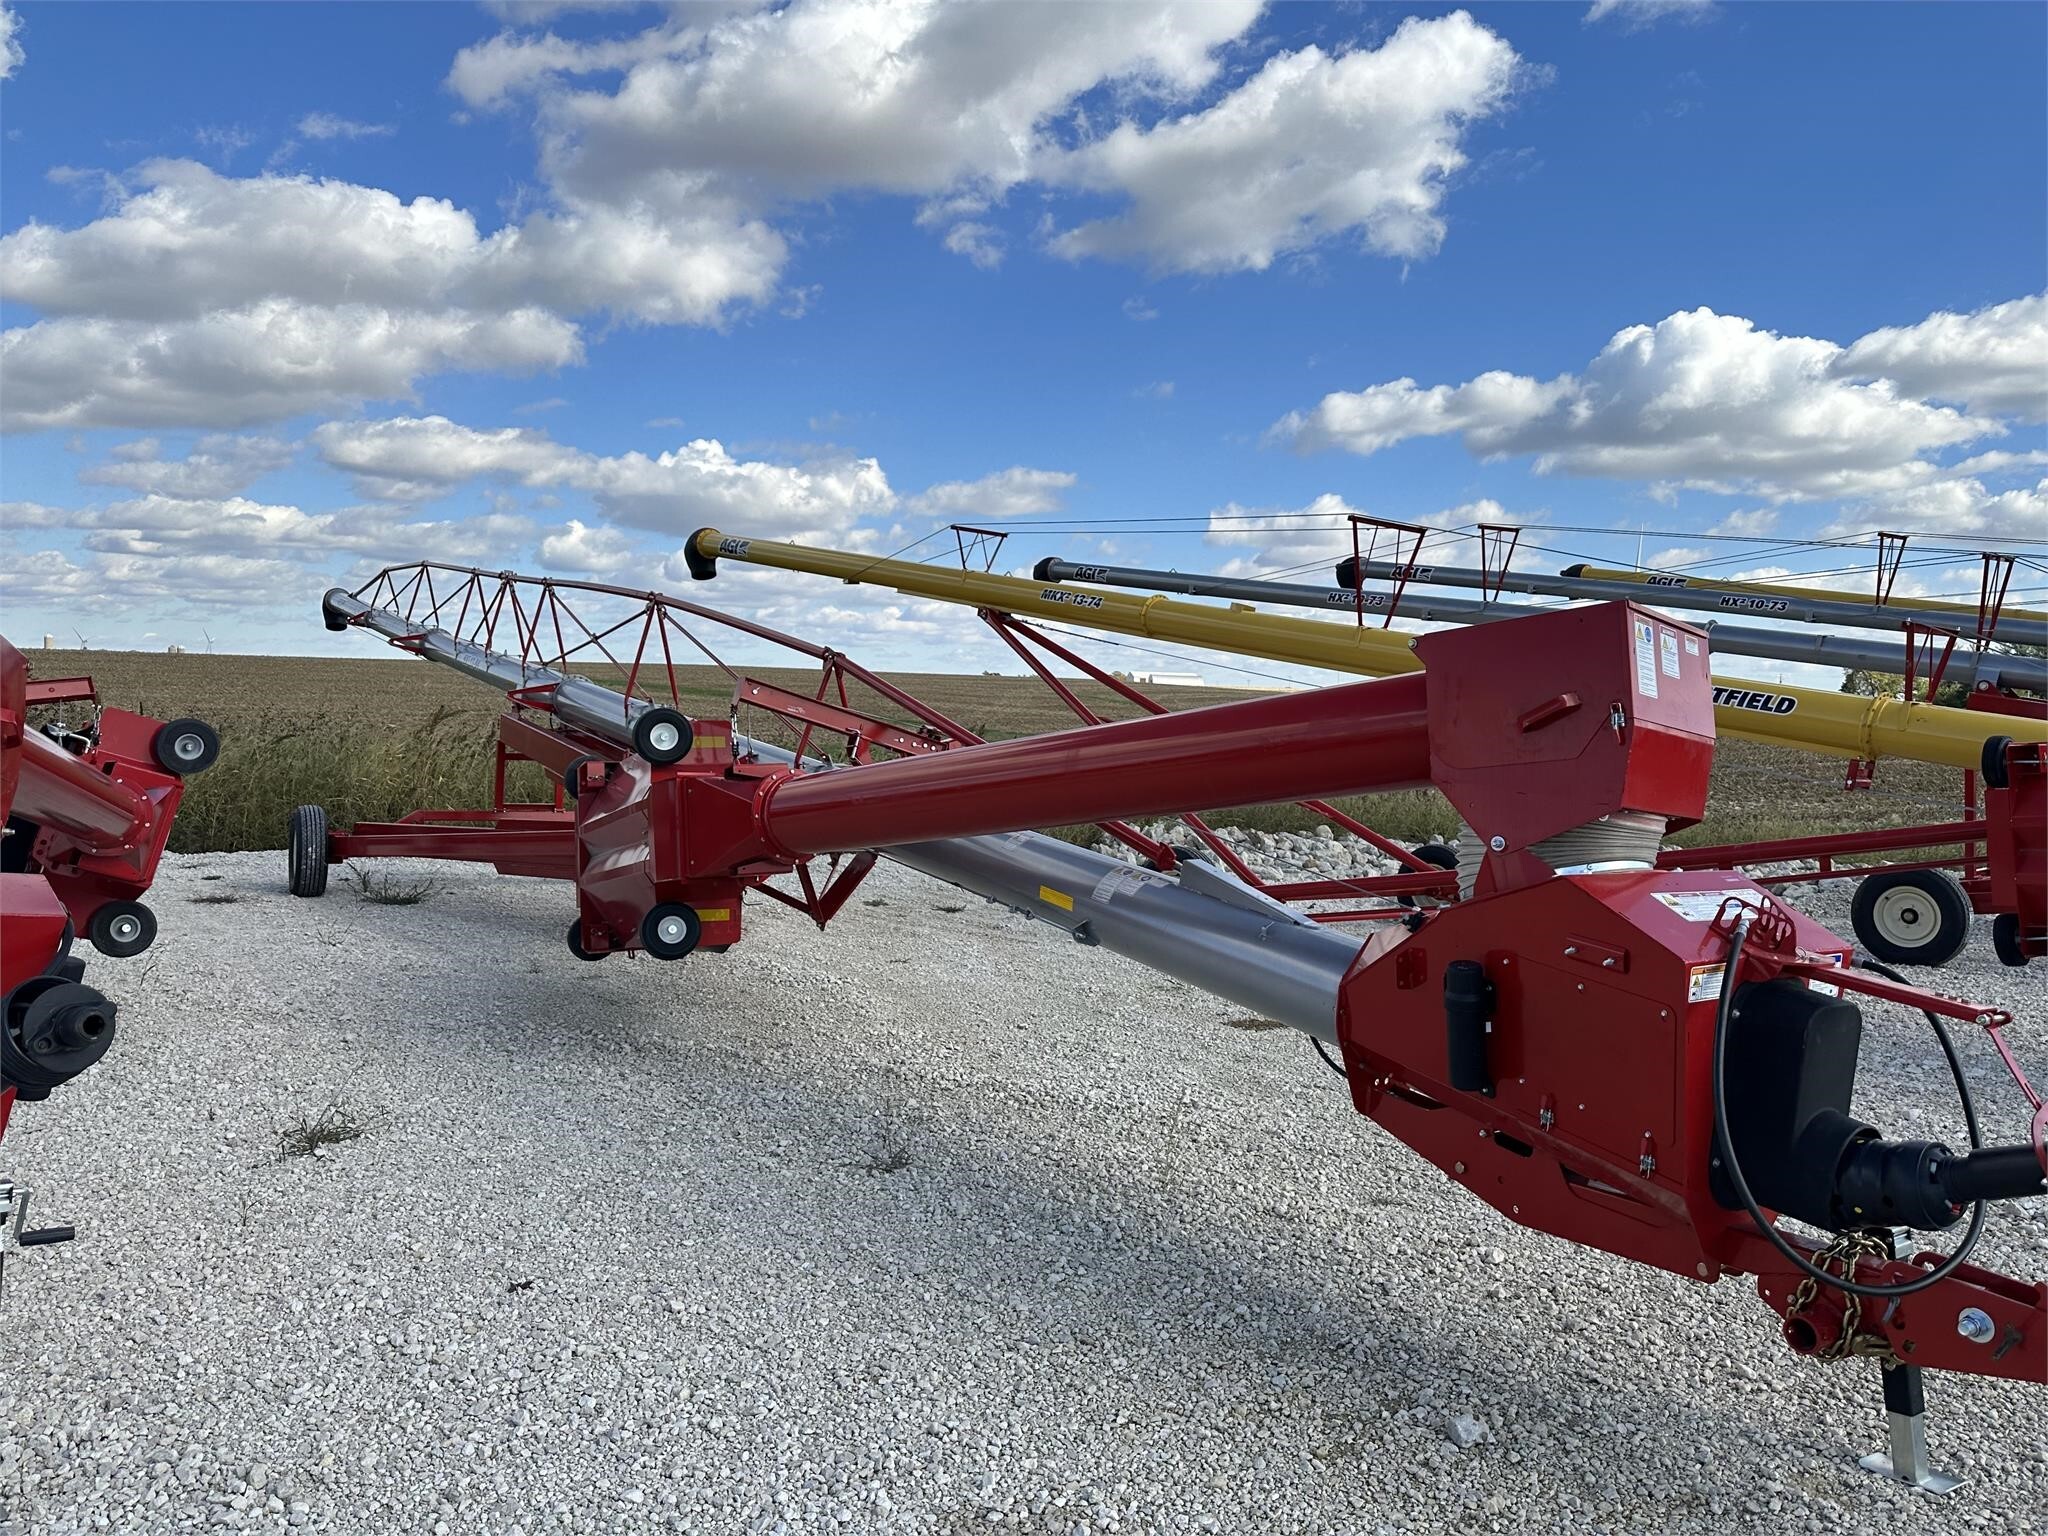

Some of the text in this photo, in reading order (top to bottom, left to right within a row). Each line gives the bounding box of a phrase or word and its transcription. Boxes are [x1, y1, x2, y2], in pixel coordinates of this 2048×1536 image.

[719, 538, 742, 555] AGI
[1073, 566, 1098, 581] AGI
[1646, 575, 1676, 587] AGI
[1072, 593, 1104, 609] 13-74
[1748, 598, 1789, 612] 10-73
[1712, 686, 1798, 715] TFIELD
